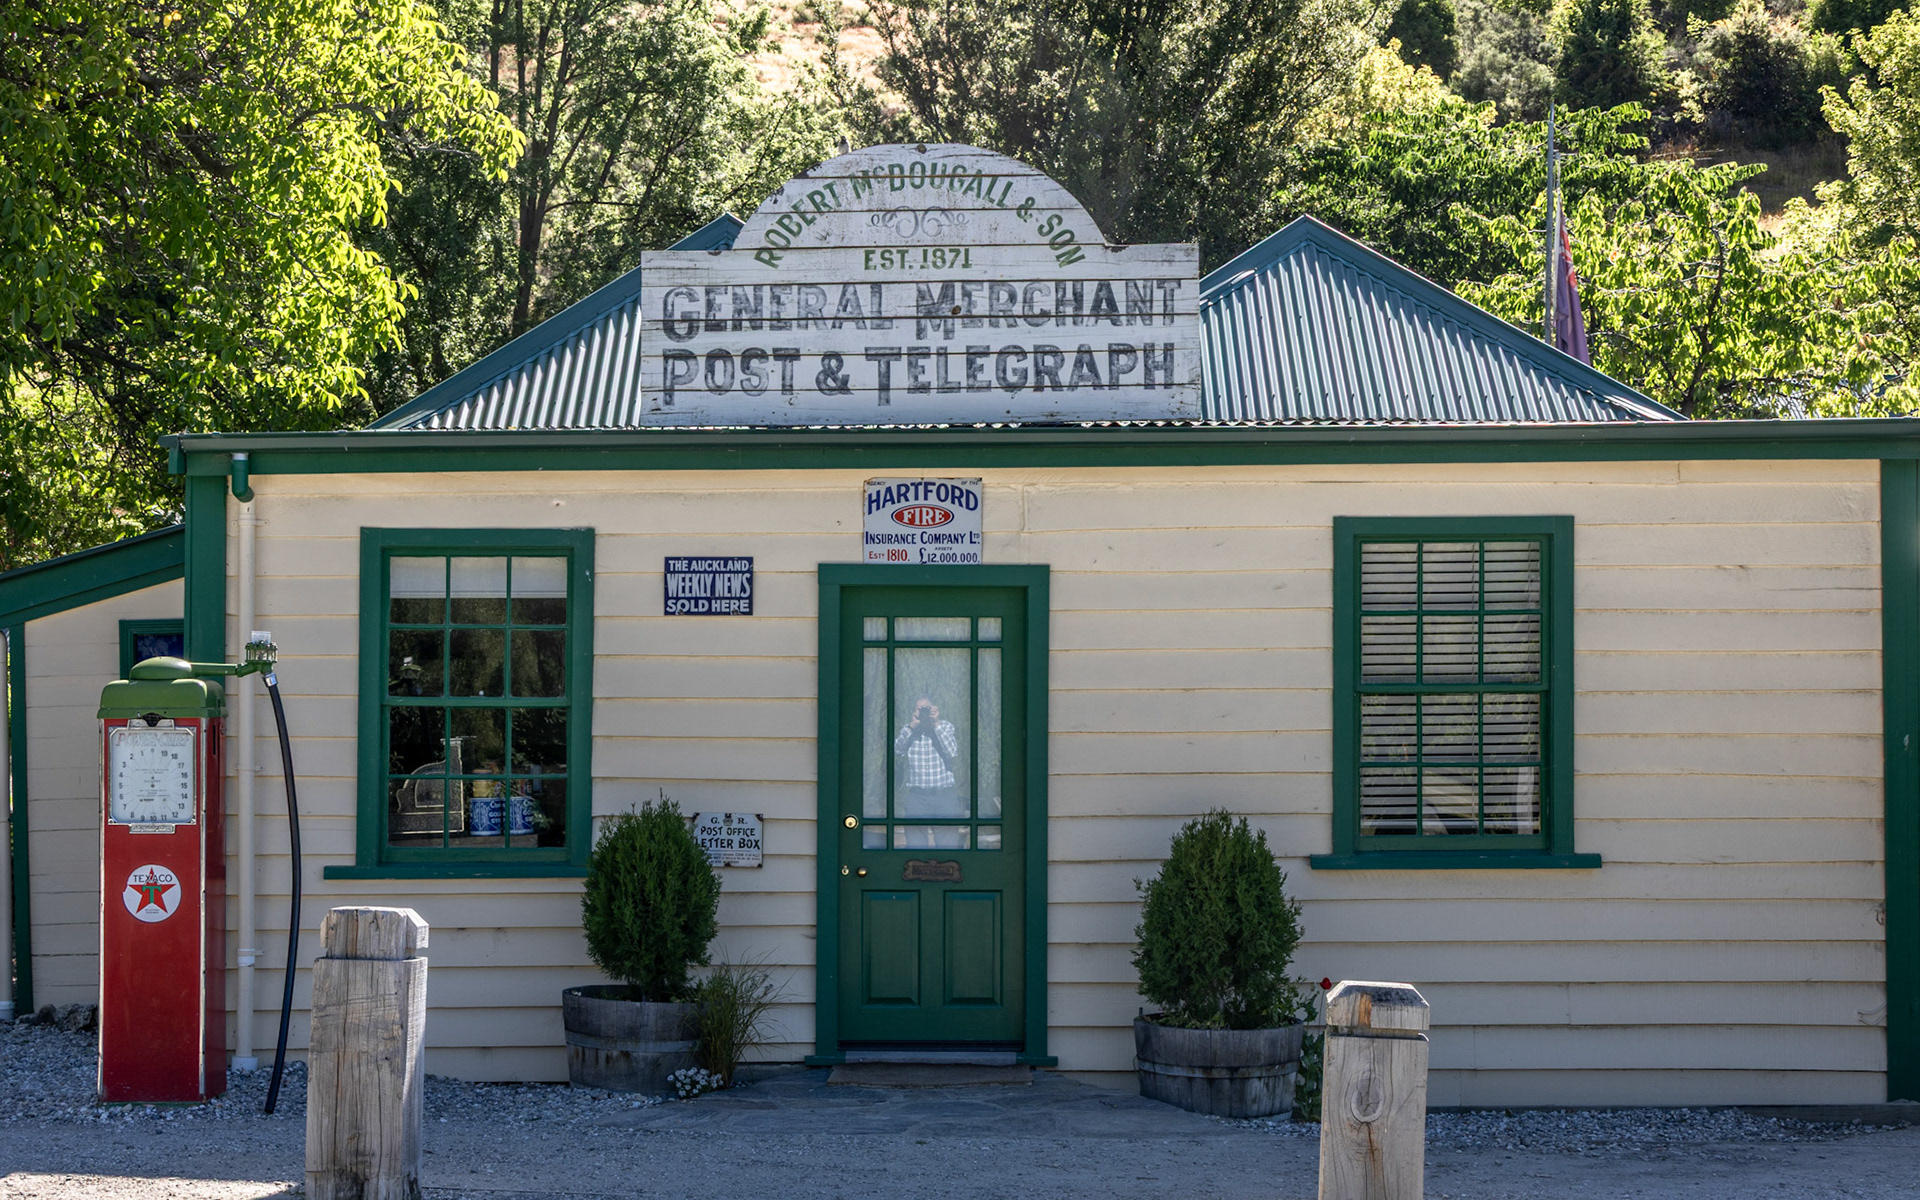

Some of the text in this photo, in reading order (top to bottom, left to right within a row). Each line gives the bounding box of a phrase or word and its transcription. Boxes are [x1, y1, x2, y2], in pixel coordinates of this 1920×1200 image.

[754, 180, 842, 269] ROBERT
[1015, 196, 1036, 223] &
[1037, 213, 1086, 268] SON
[919, 248, 973, 270] 1871
[663, 280, 1182, 343] GENERAL MERCHANT
[663, 342, 1176, 406] POST & TELEGRAPH
[867, 481, 979, 515] HARTFORD
[902, 507, 945, 526] FIRE
[865, 531, 917, 545] INSURANCE
[920, 531, 966, 545] COMPANY
[887, 549, 910, 562] 1810.
[668, 560, 749, 571] THE AUCKLAND
[666, 572, 751, 598] WEEKLY NEWS
[666, 599, 750, 613] SOLD HERE
[700, 826, 756, 837] POST OFFICE
[738, 837, 760, 850] BOX
[133, 874, 173, 882] TEXACO
